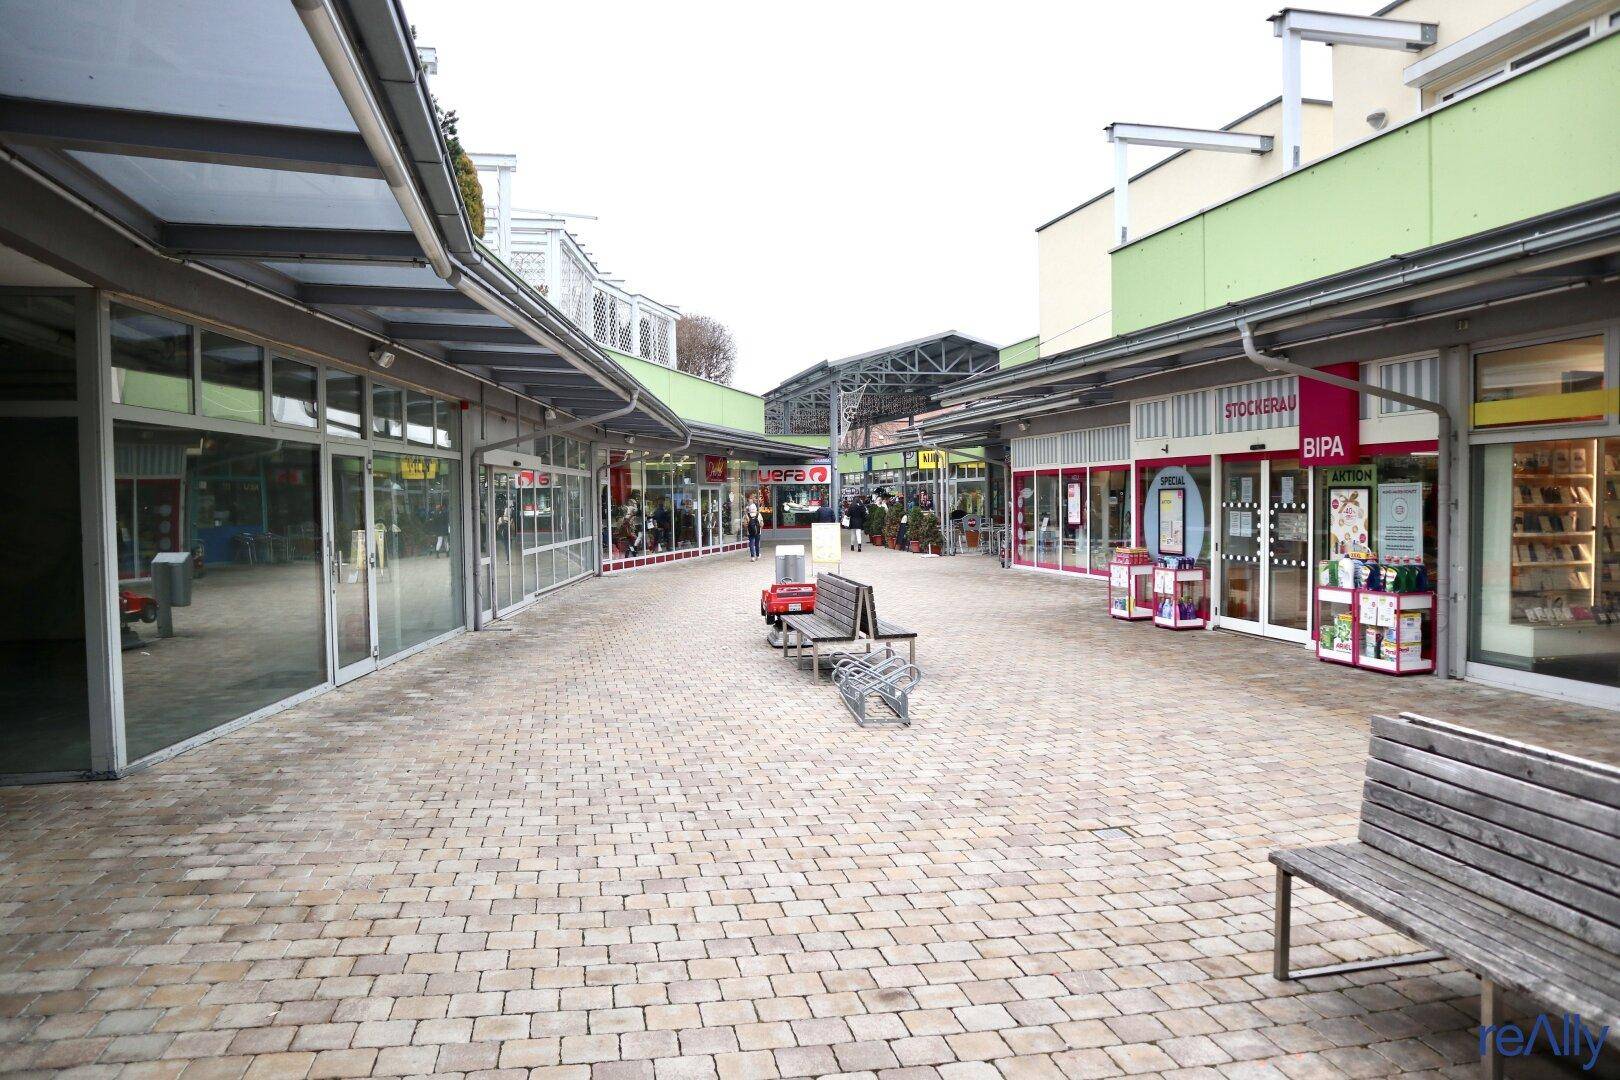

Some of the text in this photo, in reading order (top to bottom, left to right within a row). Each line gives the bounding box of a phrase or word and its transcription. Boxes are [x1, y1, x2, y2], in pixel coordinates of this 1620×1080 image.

[1225, 394, 1297, 419] STOCKERAU
[1303, 435, 1345, 459] BIPA
[755, 468, 806, 482] uefa
[1160, 476, 1186, 486] SPECIAL
[1332, 469, 1372, 482] AKTION
